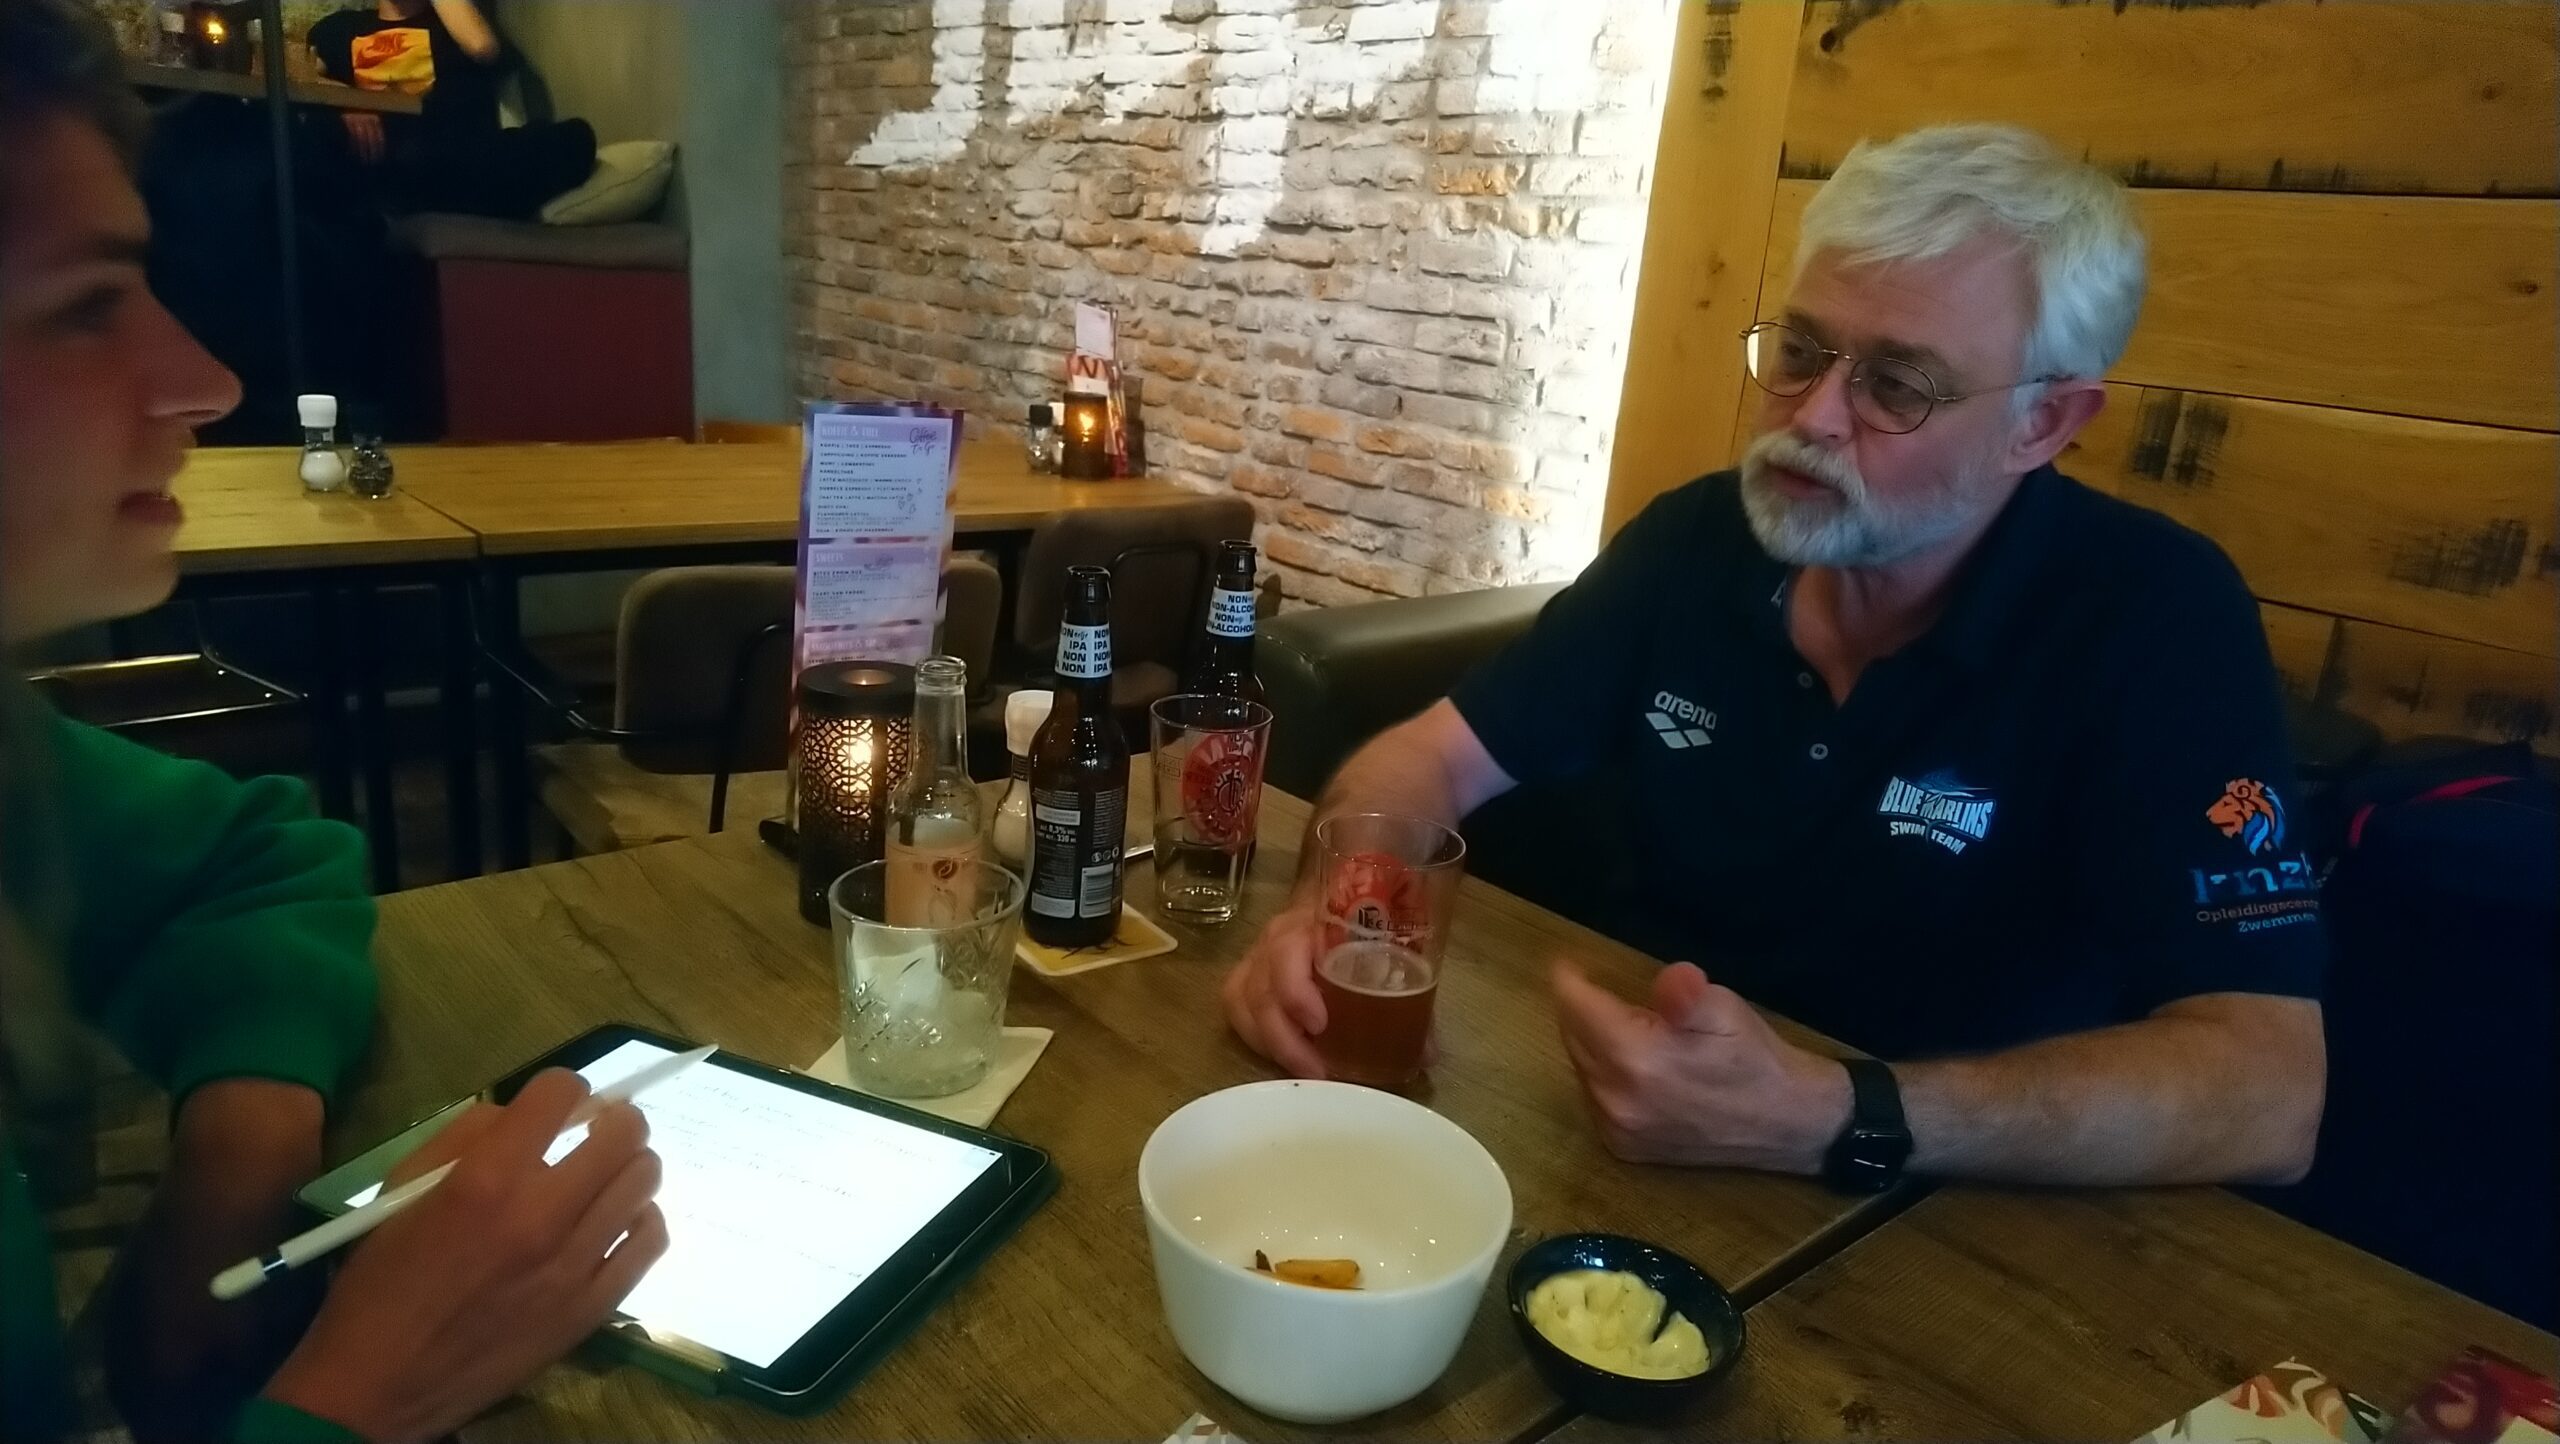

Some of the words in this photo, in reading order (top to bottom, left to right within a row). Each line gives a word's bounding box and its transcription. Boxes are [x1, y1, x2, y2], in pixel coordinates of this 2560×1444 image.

[909, 427, 937, 444] Coffee
[1069, 640, 1087, 651] IPA
[1094, 640, 1108, 650] IPA
[1063, 650, 1087, 662] NON
[1062, 662, 1086, 673] NON
[1094, 662, 1108, 673] IPA
[1654, 690, 1718, 730] arena
[1880, 776, 1925, 812] BLUE
[1919, 793, 1994, 839] MARLINS
[1890, 820, 1926, 837] SWIM
[1931, 829, 1967, 855] TEAM
